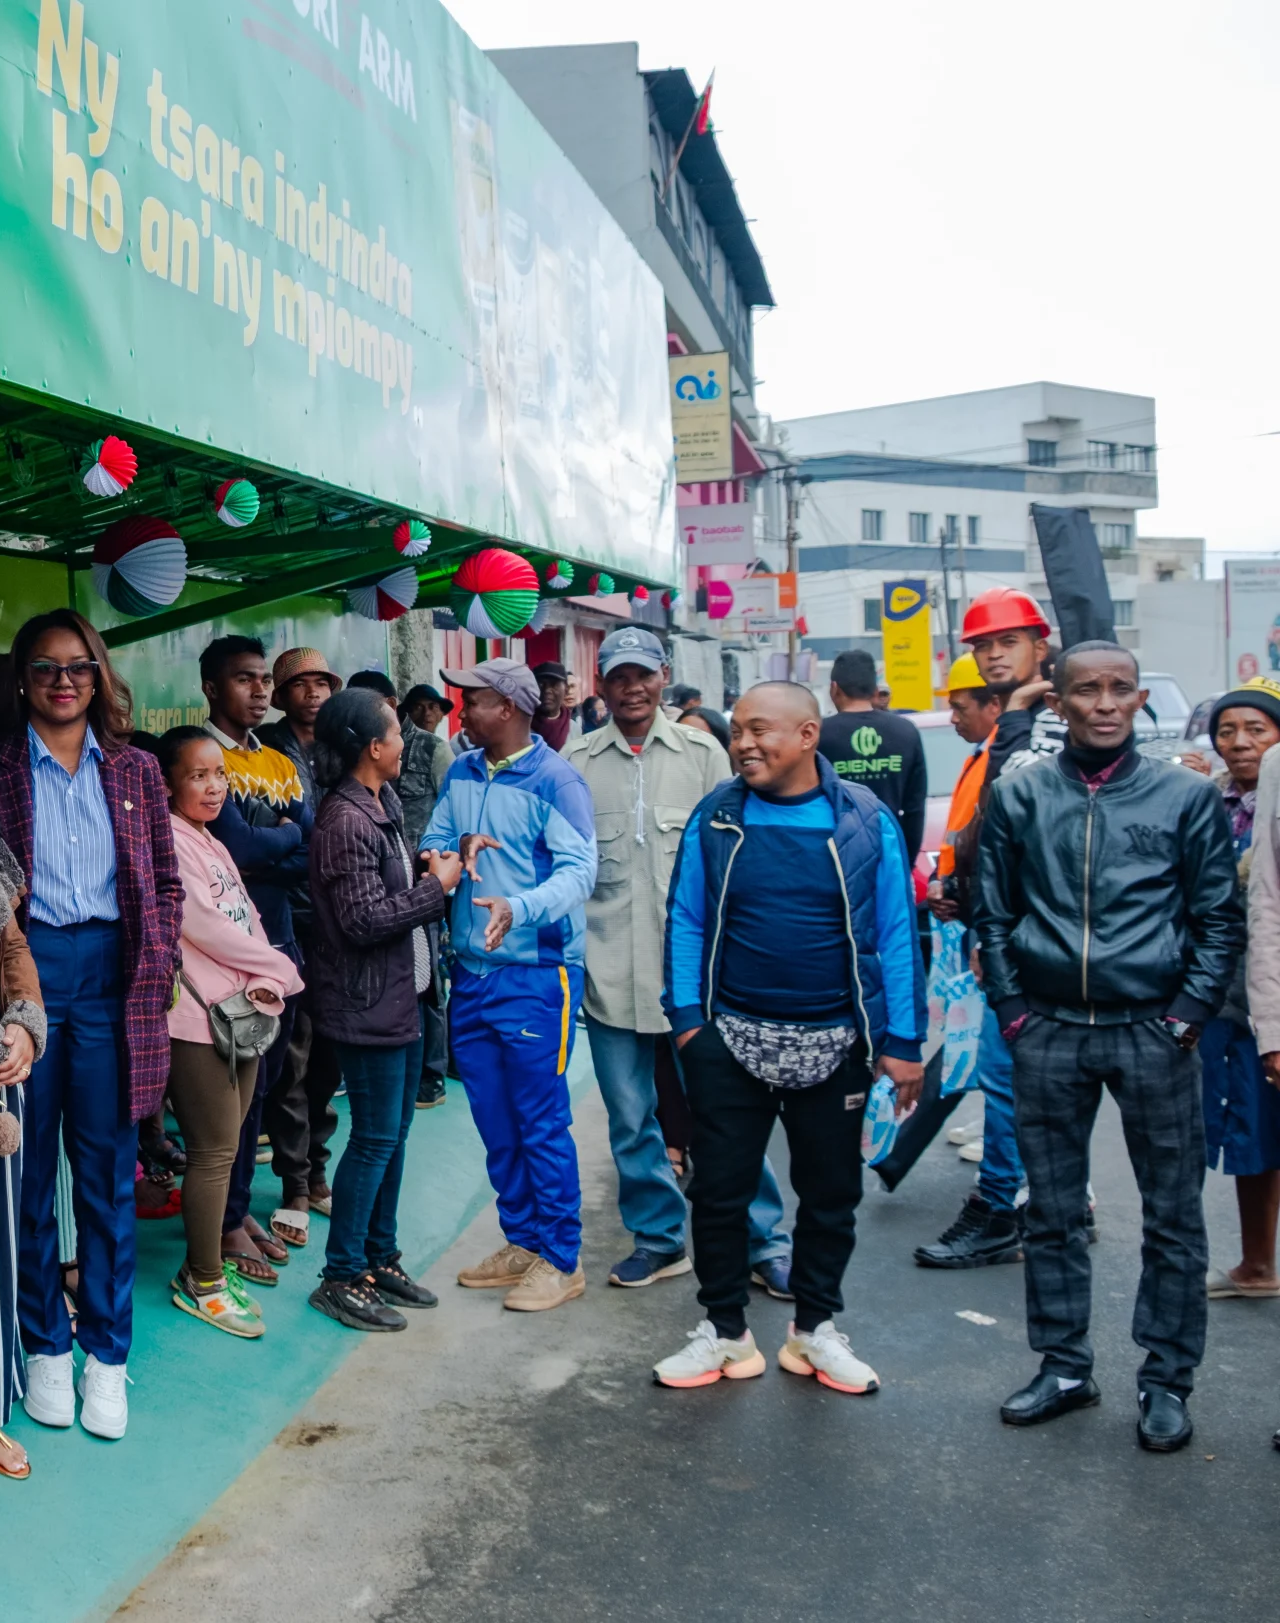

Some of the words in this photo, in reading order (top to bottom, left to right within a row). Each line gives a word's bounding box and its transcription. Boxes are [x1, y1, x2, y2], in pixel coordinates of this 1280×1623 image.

[37, 0, 119, 157] Ny
[147, 68, 264, 228] tsara
[275, 150, 412, 318] indrindra
[52, 108, 123, 254] ho
[273, 269, 412, 415] mpiompy
[701, 525, 745, 535] baobab
[141, 702, 181, 733] tsara
